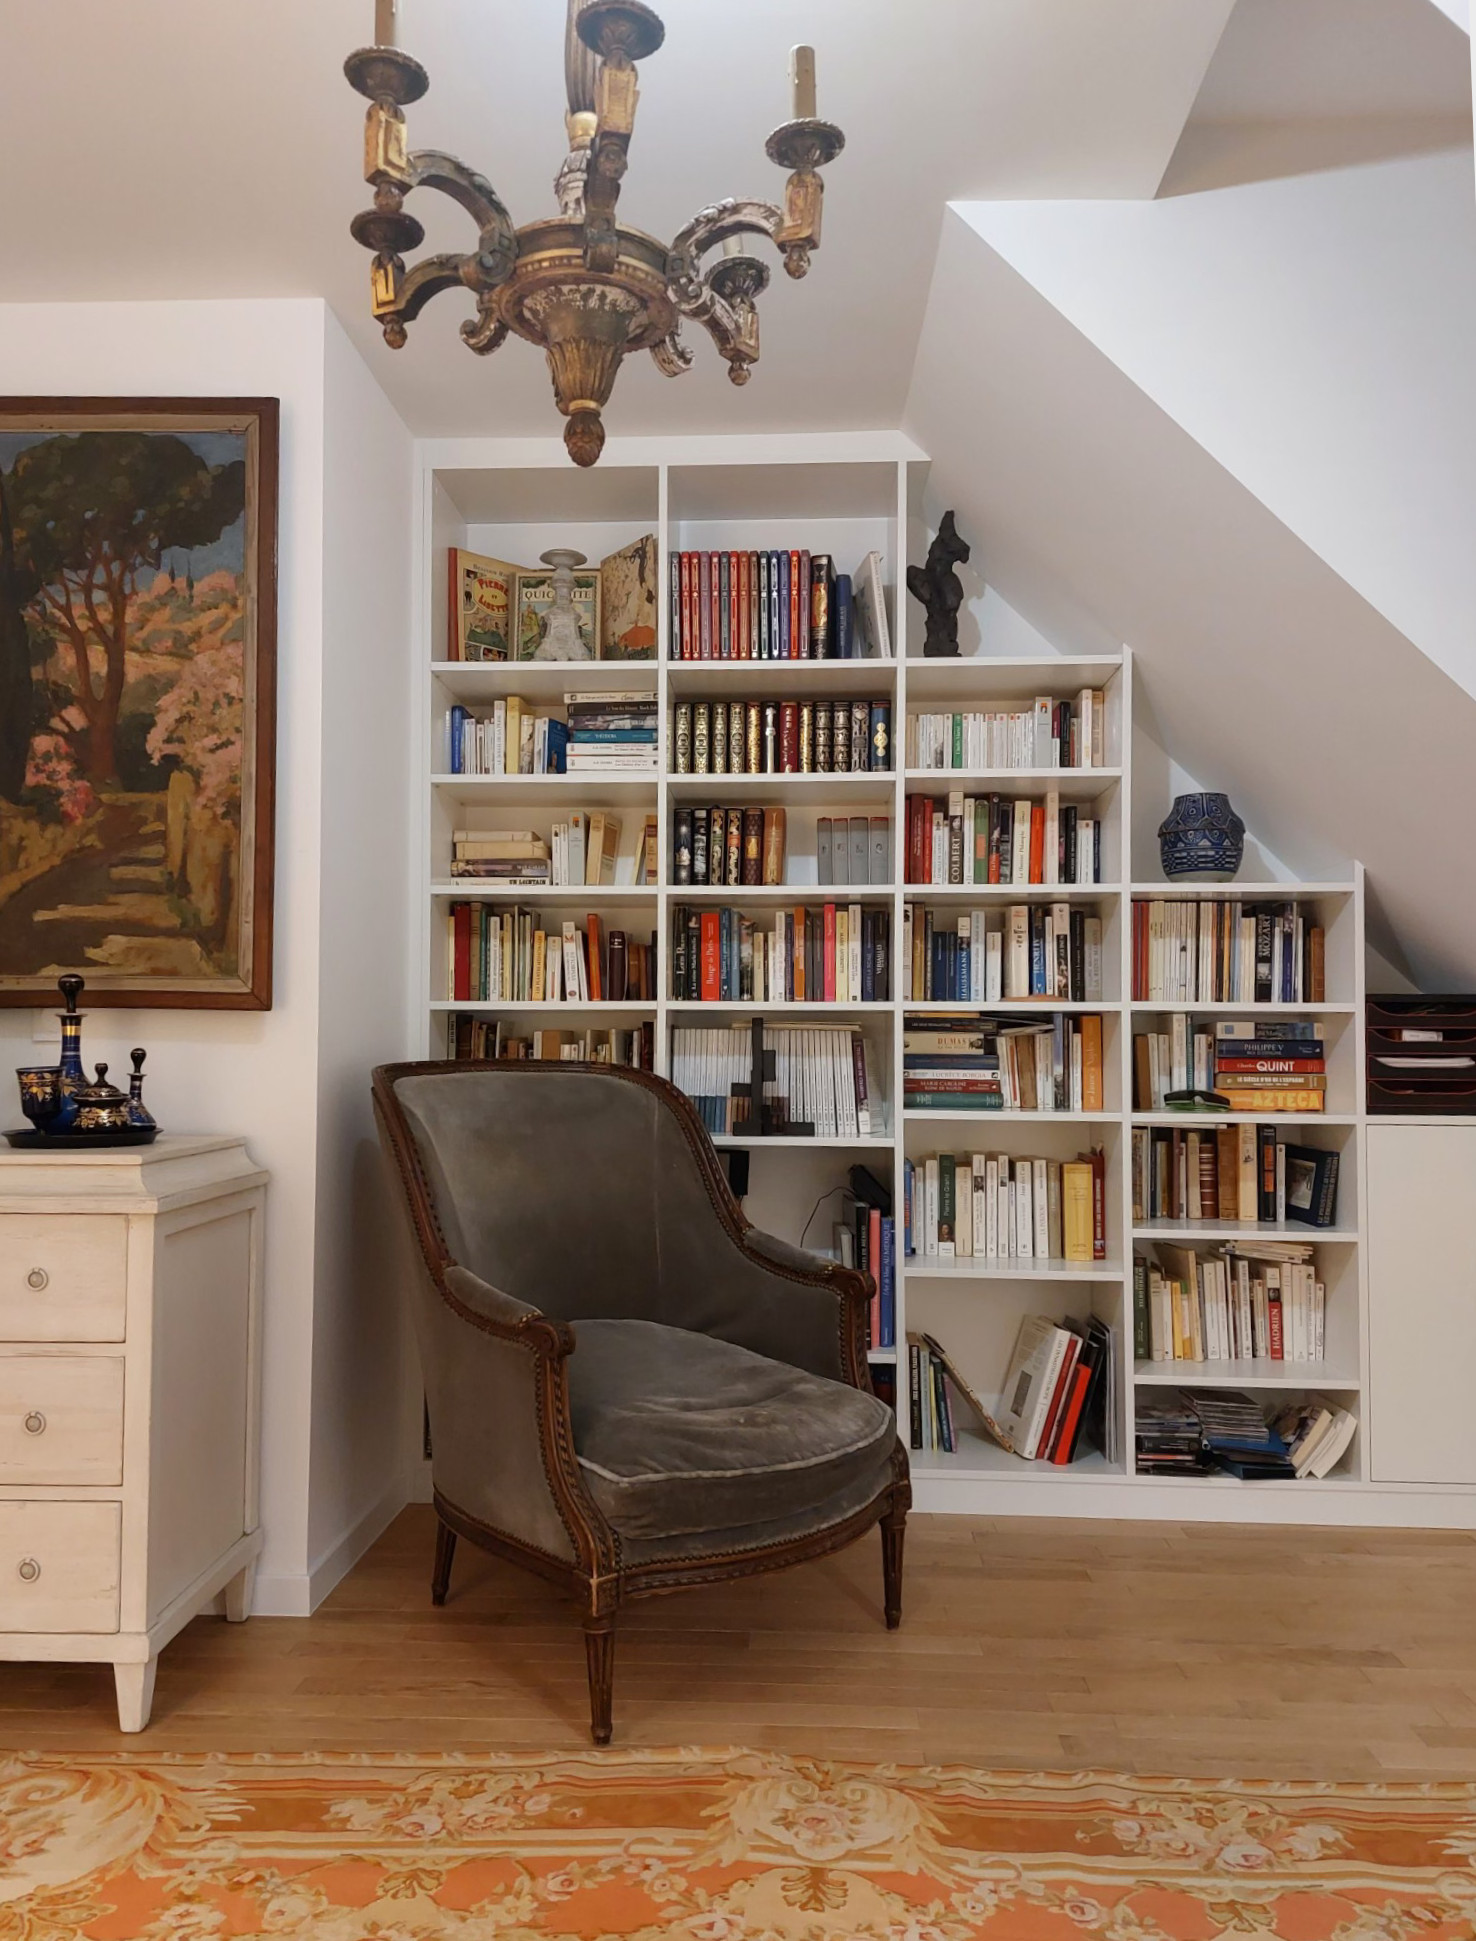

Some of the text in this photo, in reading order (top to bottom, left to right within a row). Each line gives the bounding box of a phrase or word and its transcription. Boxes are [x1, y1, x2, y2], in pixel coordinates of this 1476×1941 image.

[525, 590, 592, 600] QUICTTE
[951, 836, 960, 883] COLBERT
[1262, 915, 1271, 957] MOZART
[1256, 1061, 1295, 1072] QUINT
[1252, 1092, 1320, 1107] AZTECA
[1271, 1308, 1281, 1349] HADRIEN
